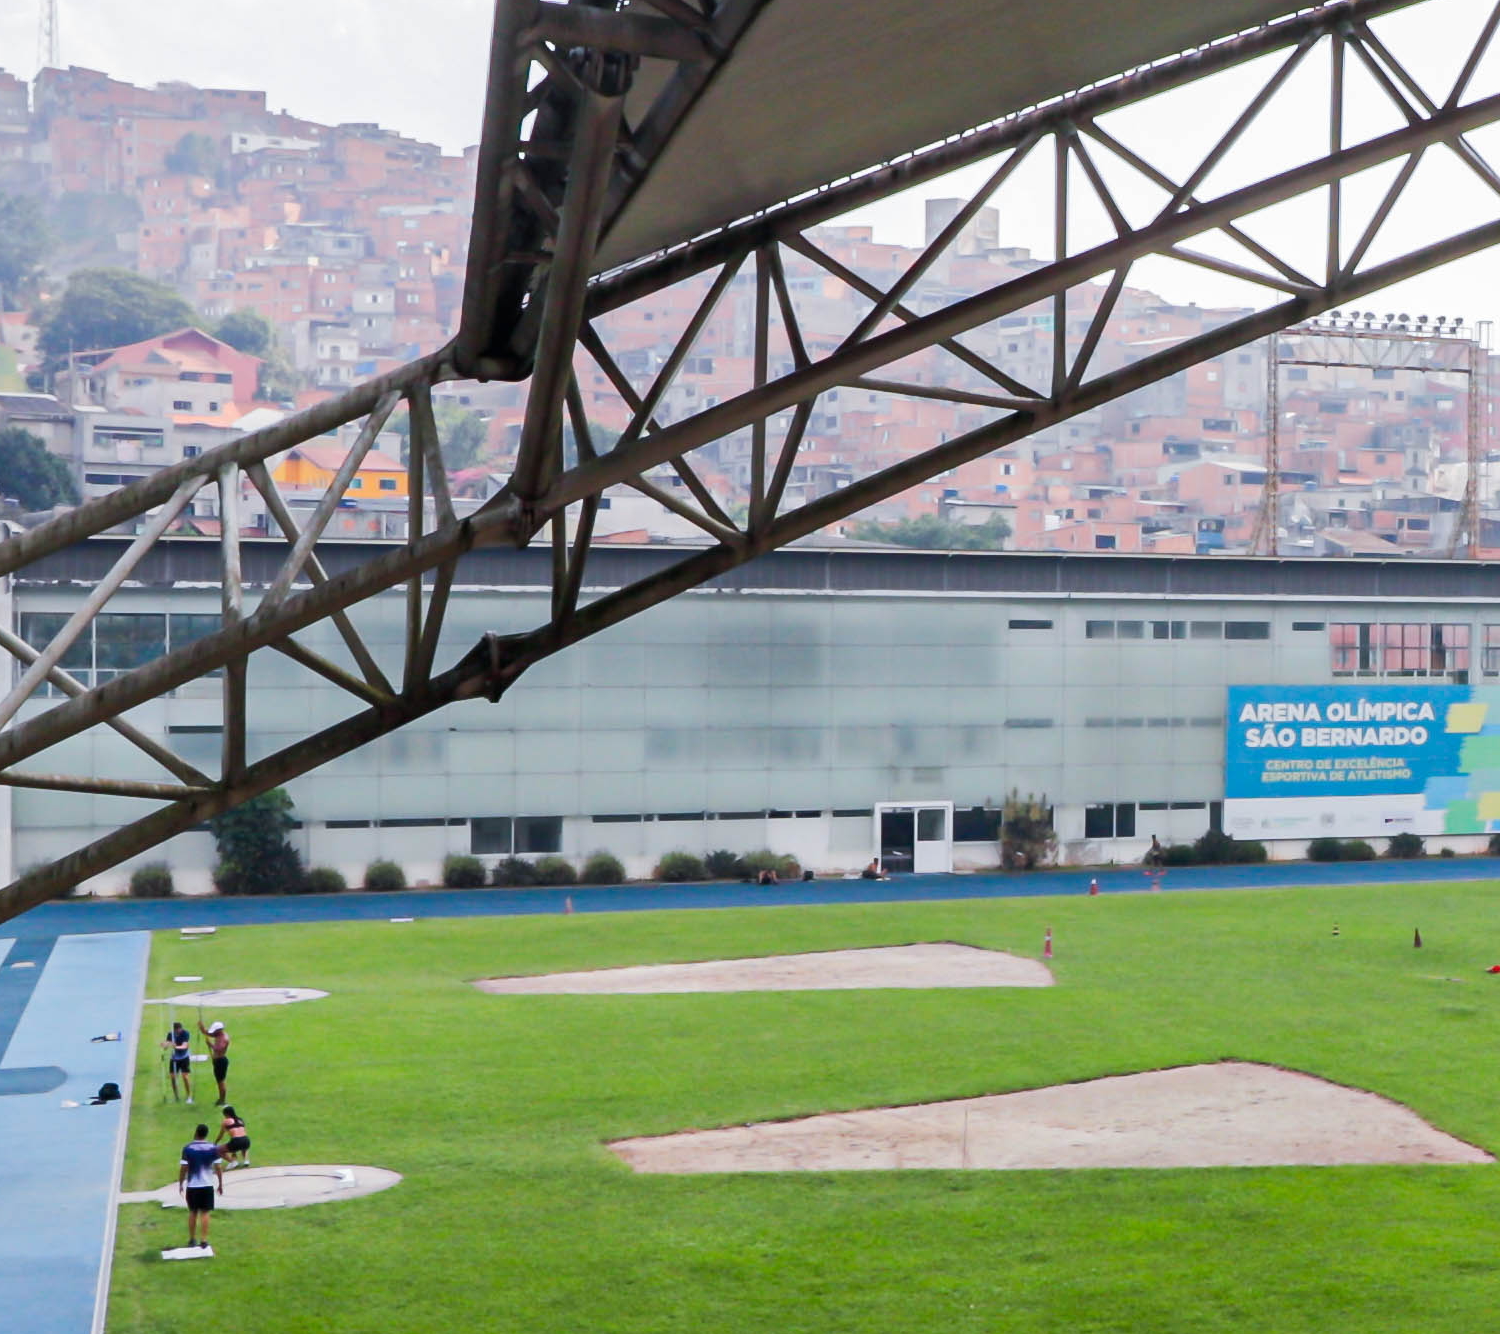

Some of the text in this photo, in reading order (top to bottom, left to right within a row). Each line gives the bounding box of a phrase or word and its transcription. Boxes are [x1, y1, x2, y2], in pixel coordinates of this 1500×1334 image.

[1239, 698, 1435, 722] ARENA OLÍMPICA
[1245, 724, 1428, 747] SÃO BERNARDO
[1265, 756, 1405, 770] CENTRO DE EXCELÊNCIA
[1261, 768, 1411, 783] ESPORTIVA DE ATLETISMO
